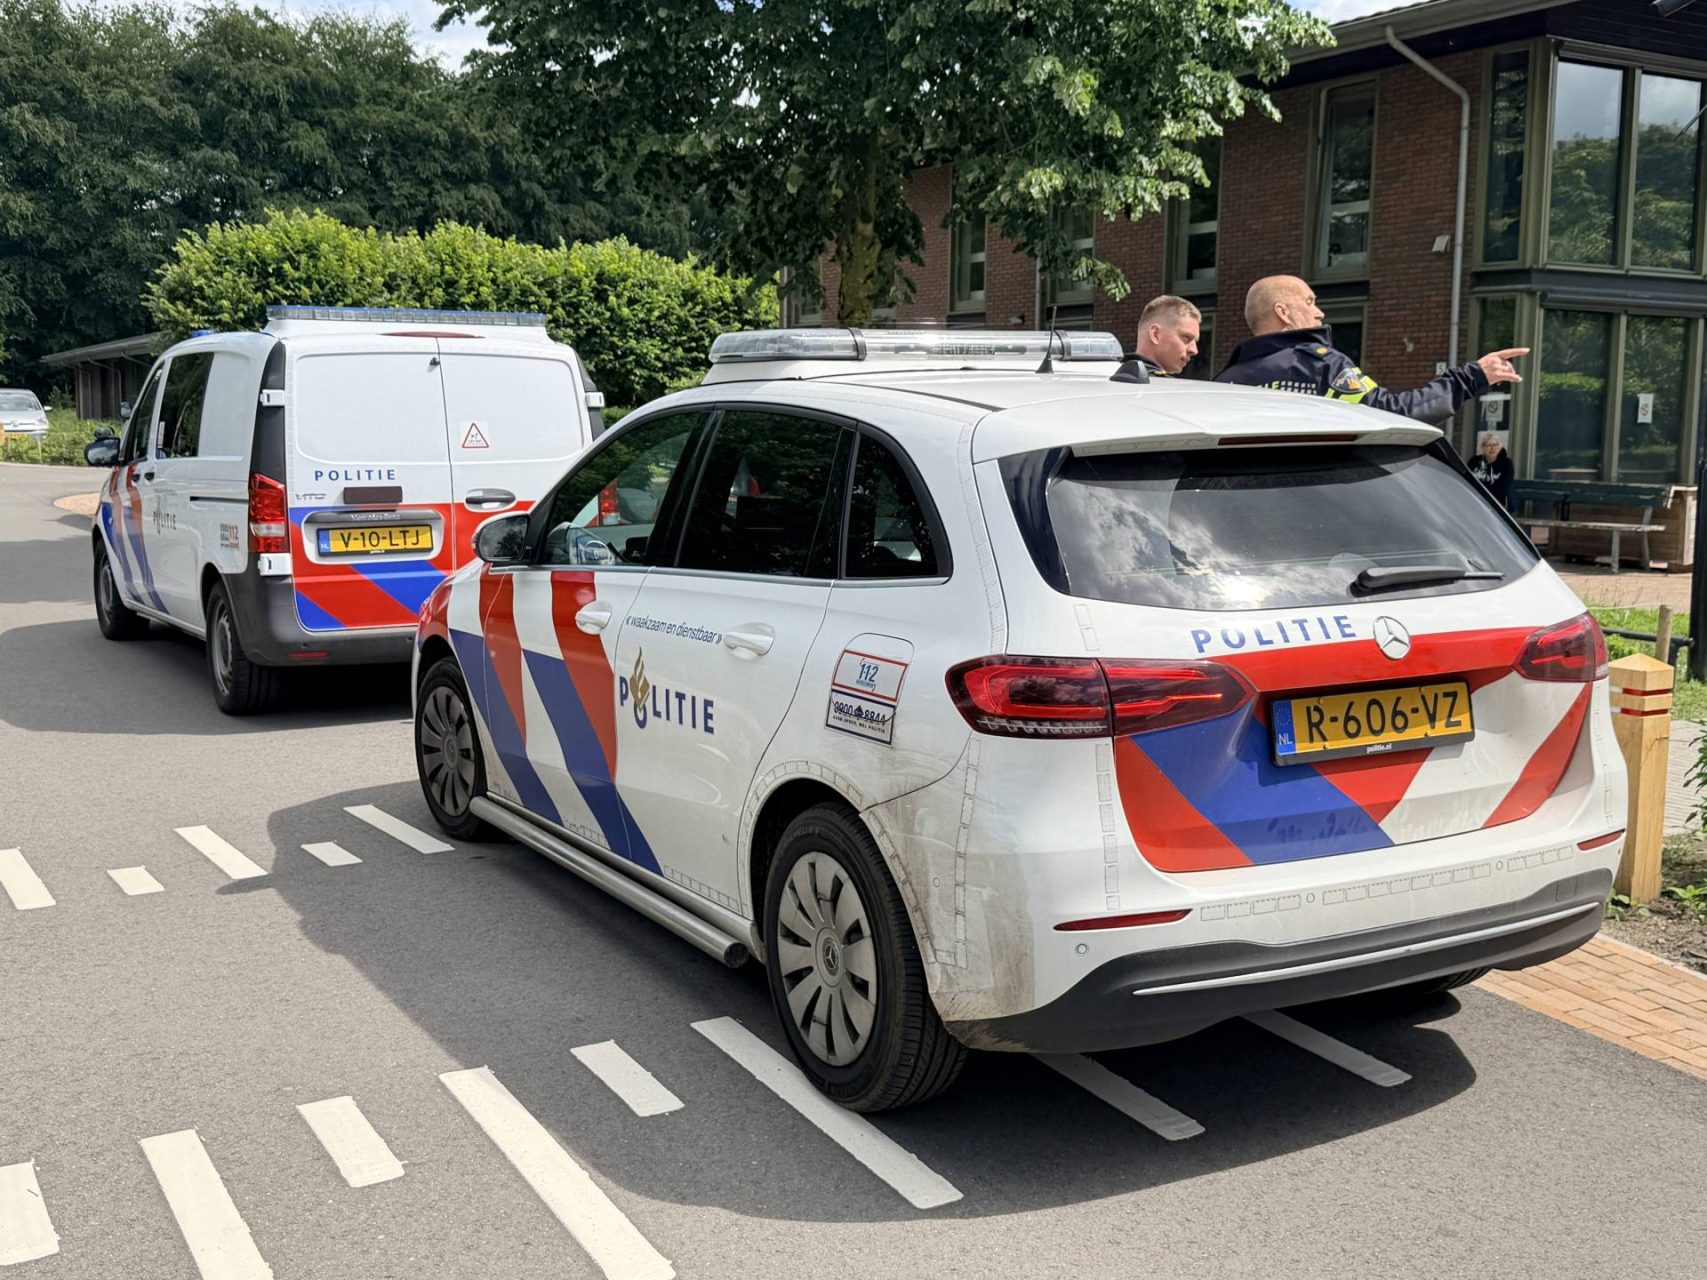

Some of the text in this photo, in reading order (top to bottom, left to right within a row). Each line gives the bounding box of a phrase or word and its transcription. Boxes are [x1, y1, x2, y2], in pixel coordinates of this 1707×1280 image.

[314, 469, 396, 481] POLITIE
[339, 529, 420, 549] V-10-LTJ
[1191, 615, 1357, 653] POLITIE
[618, 675, 715, 735] POLITIE
[1278, 691, 1463, 746] NL R-606-VZ
[1366, 743, 1392, 755] politie.nl
